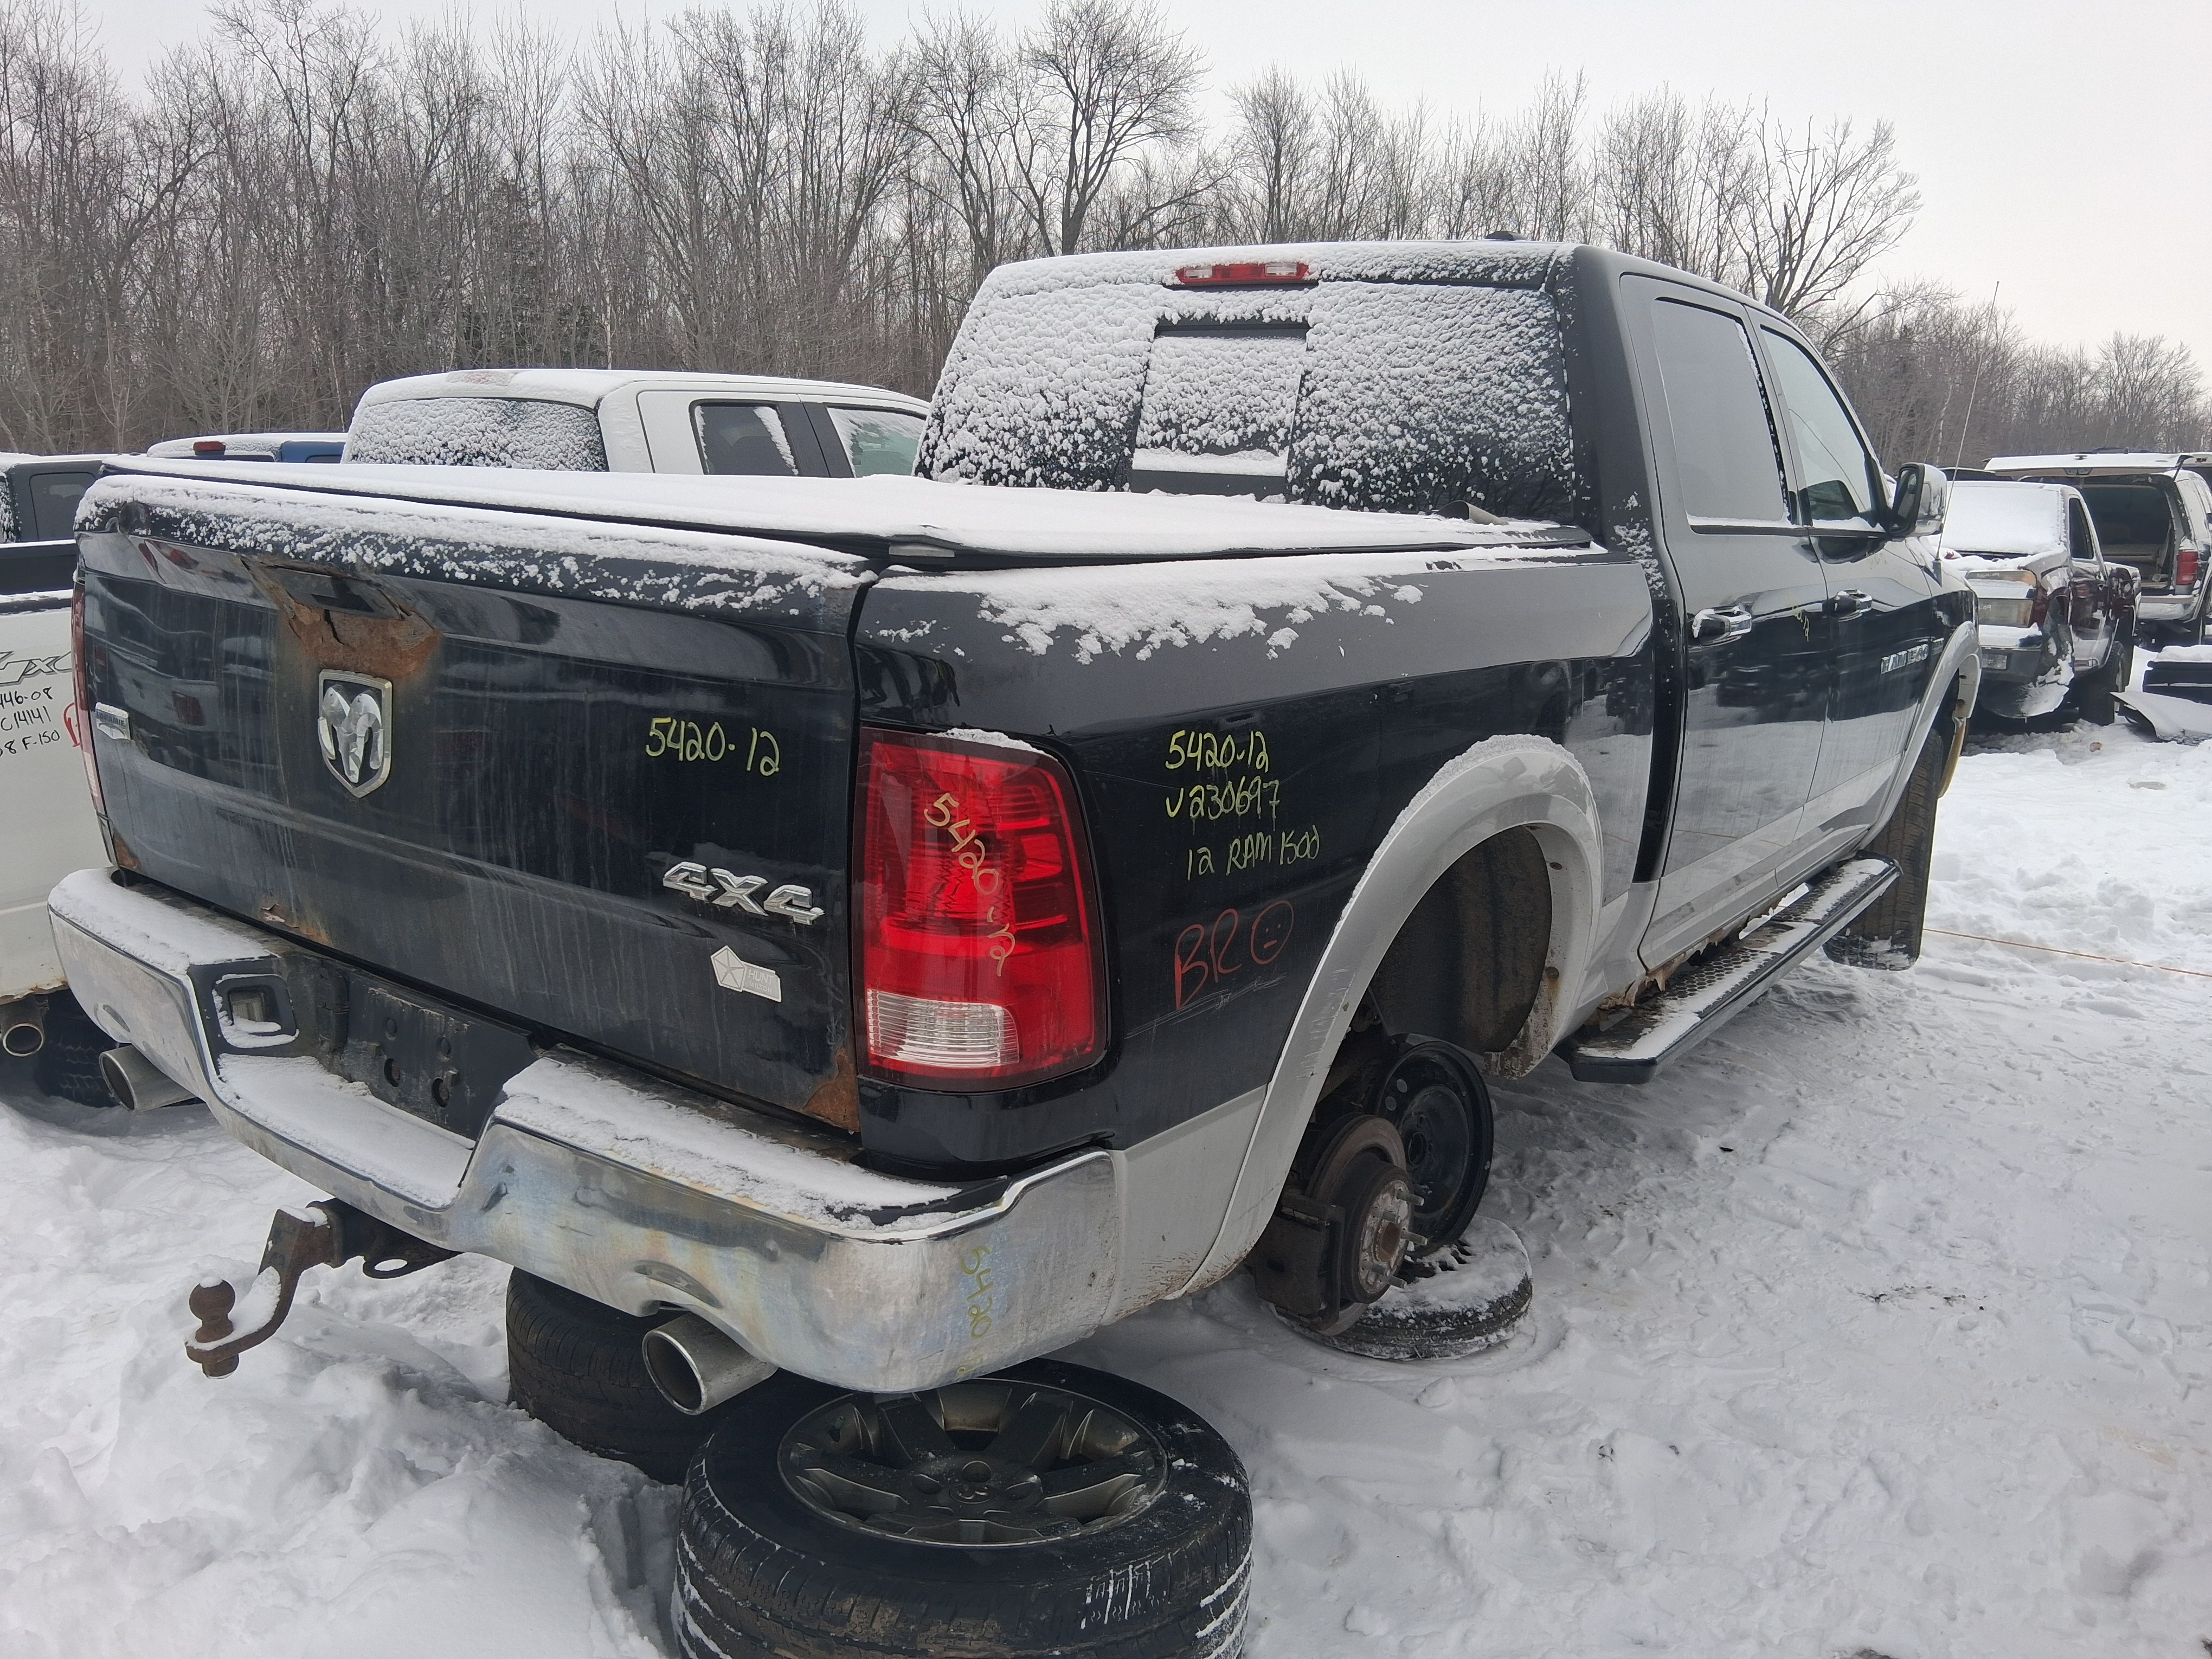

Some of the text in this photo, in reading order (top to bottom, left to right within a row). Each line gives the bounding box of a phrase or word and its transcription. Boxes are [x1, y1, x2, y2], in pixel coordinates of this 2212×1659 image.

[22, 729, 60, 750] F-150
[1226, 832, 1272, 876] RAM
[748, 968, 775, 985] HUNT
[749, 981, 772, 993] MILTON
